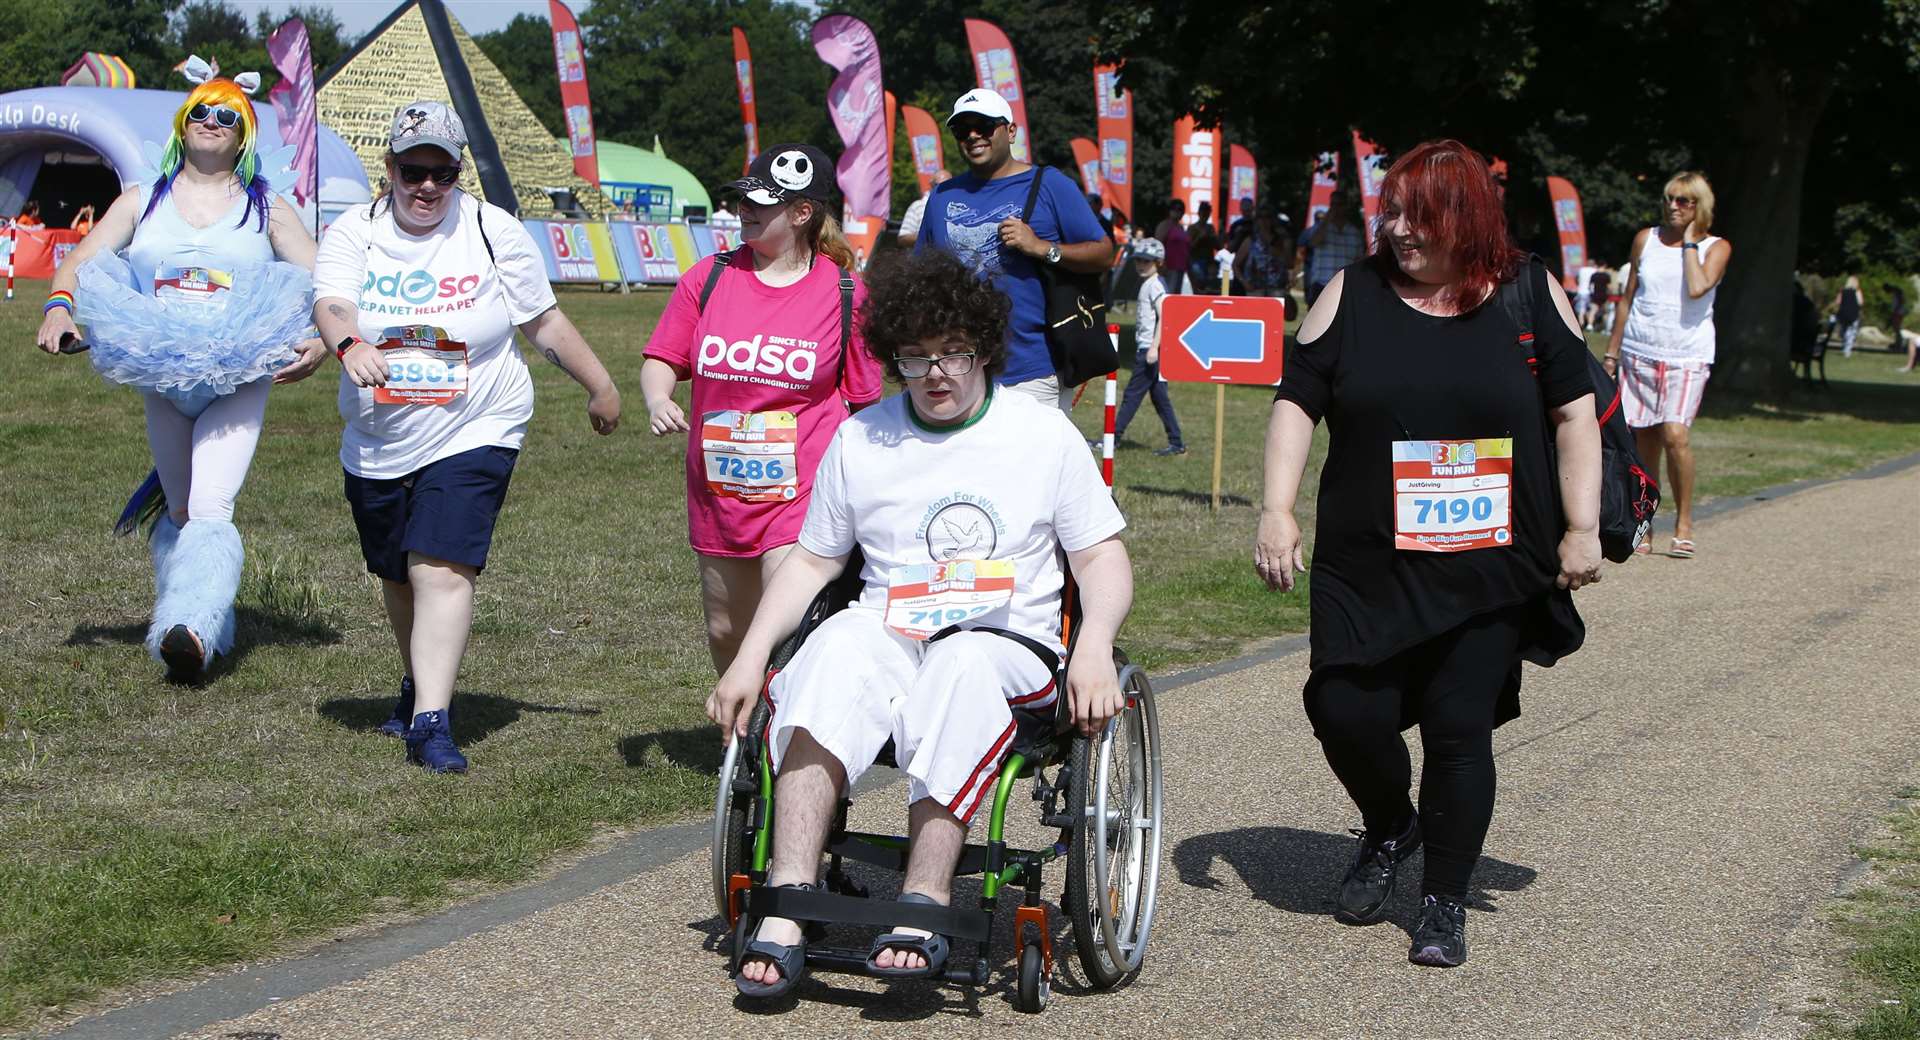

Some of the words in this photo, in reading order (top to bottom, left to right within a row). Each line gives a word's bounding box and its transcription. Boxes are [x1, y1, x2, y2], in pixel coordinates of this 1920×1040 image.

[371, 49, 393, 57] 100
[388, 41, 420, 50] belief
[332, 79, 400, 88] confidence
[384, 88, 416, 98] spirit
[0, 104, 24, 128] lp
[32, 104, 81, 135] Desk
[551, 223, 594, 261] BIG
[634, 225, 676, 261] BIG
[560, 264, 578, 278] FUN
[579, 264, 598, 278] RUN
[378, 305, 386, 313] A
[390, 306, 412, 315] VET
[415, 304, 443, 315] HELP
[446, 303, 454, 312] A
[768, 336, 796, 346] SINCE
[798, 340, 818, 350] 1917
[697, 334, 817, 380] pdsa
[704, 371, 728, 380] SAVING
[729, 375, 748, 383] PETS
[749, 376, 792, 389] CHANGING
[731, 413, 766, 432] BIG
[730, 432, 745, 440] FUN
[746, 432, 766, 440] RUN
[1431, 443, 1476, 465] BIG
[715, 456, 784, 480] 7286
[1432, 466, 1453, 475] FUN
[1454, 465, 1475, 475] RUN
[915, 496, 951, 540] Freedom
[953, 491, 976, 502] For
[978, 496, 1006, 536] Wheels
[1414, 496, 1492, 524] 7190
[929, 561, 976, 585] BIG
[928, 583, 949, 592] FUN
[950, 581, 976, 590] RUN
